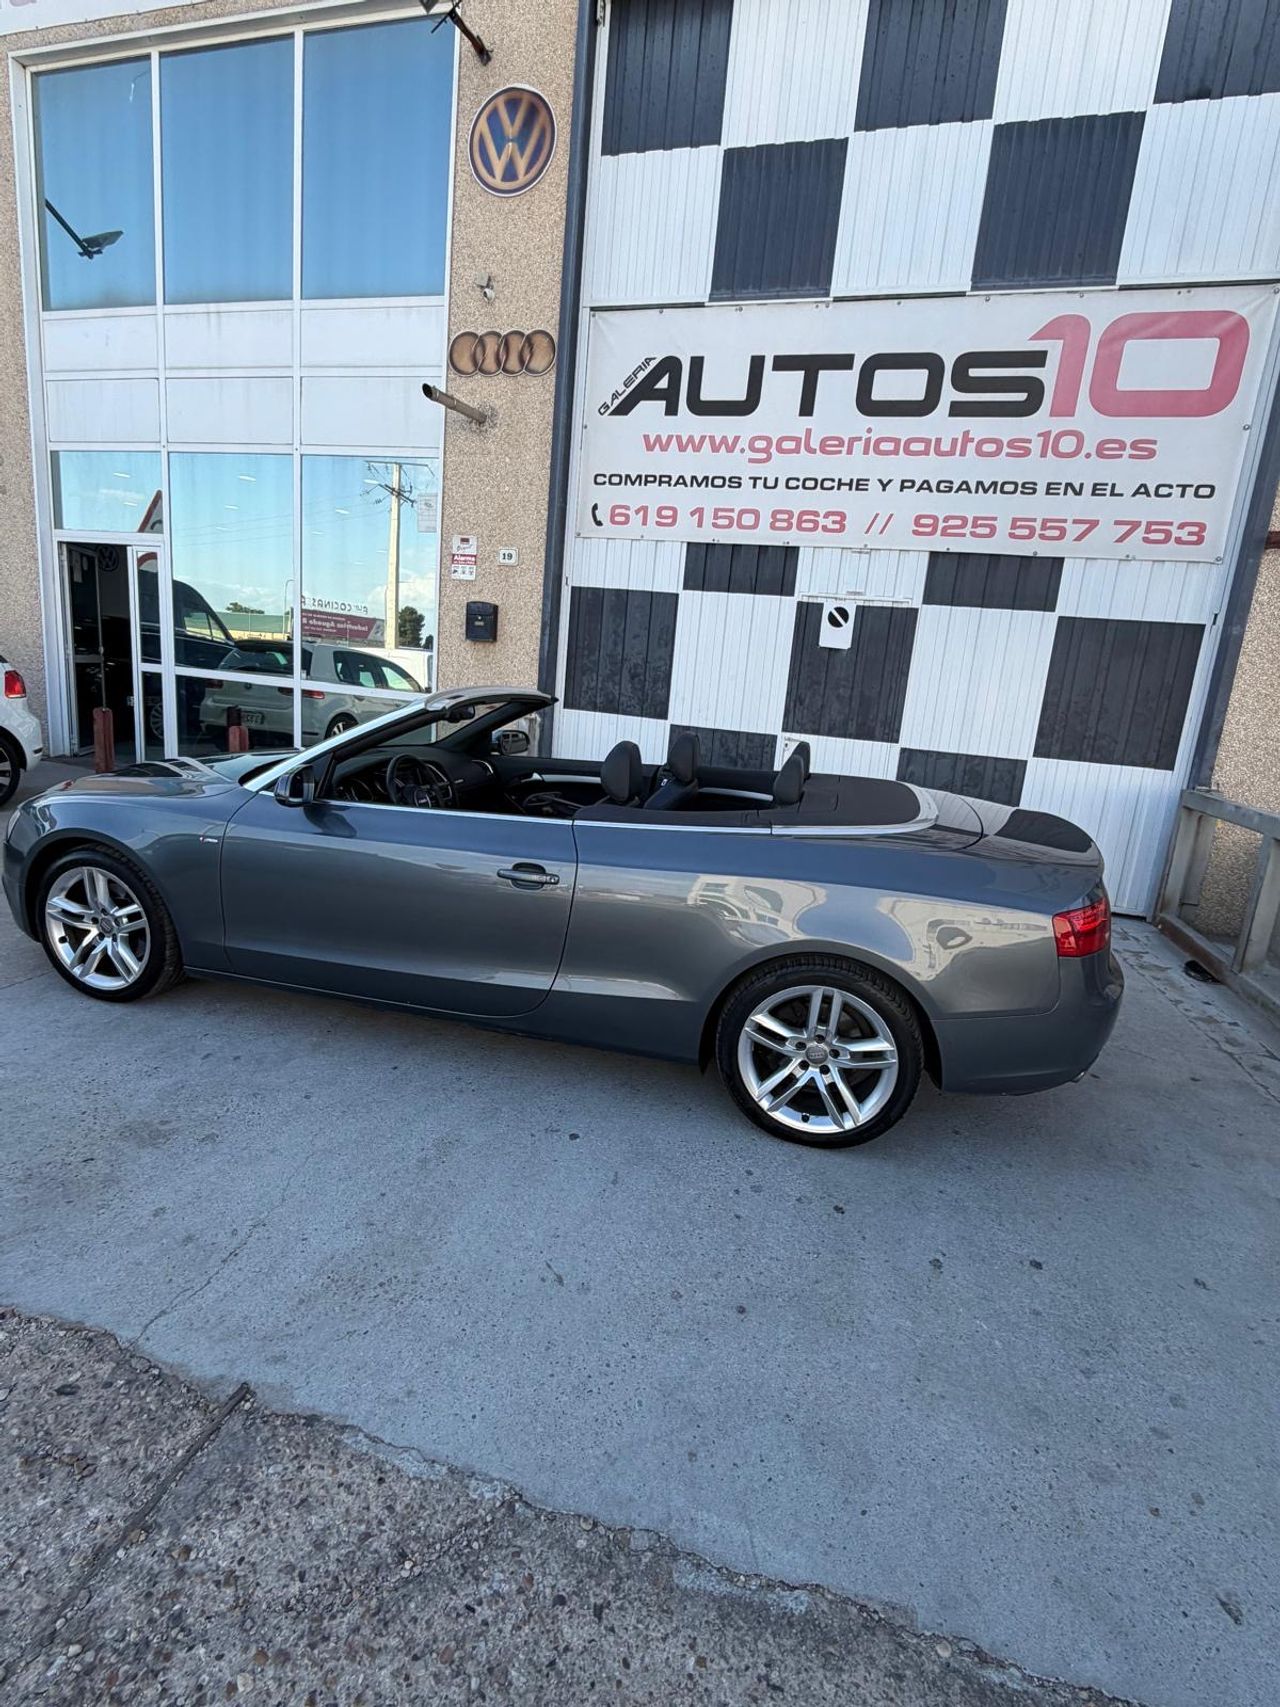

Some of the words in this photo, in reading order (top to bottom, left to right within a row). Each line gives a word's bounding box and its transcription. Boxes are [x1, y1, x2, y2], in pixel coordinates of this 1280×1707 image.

[597, 356, 657, 416] GALERIA
[642, 427, 1158, 464] www.galeriaautos10.es
[593, 473, 742, 489] COMPRAMOS
[749, 476, 778, 490] TU
[785, 477, 870, 492] COCHE
[877, 478, 894, 492] Y
[899, 479, 1038, 496] PAGAMOS
[1044, 481, 1084, 497] EN
[1090, 482, 1124, 497] EL
[1130, 483, 1216, 499] ACTO
[609, 504, 678, 528] 619
[689, 507, 760, 530] 150
[769, 509, 847, 534] 863
[911, 513, 998, 539] 925
[1007, 517, 1100, 542] 557
[1113, 519, 1207, 546] 753
[501, 552, 513, 562] 19
